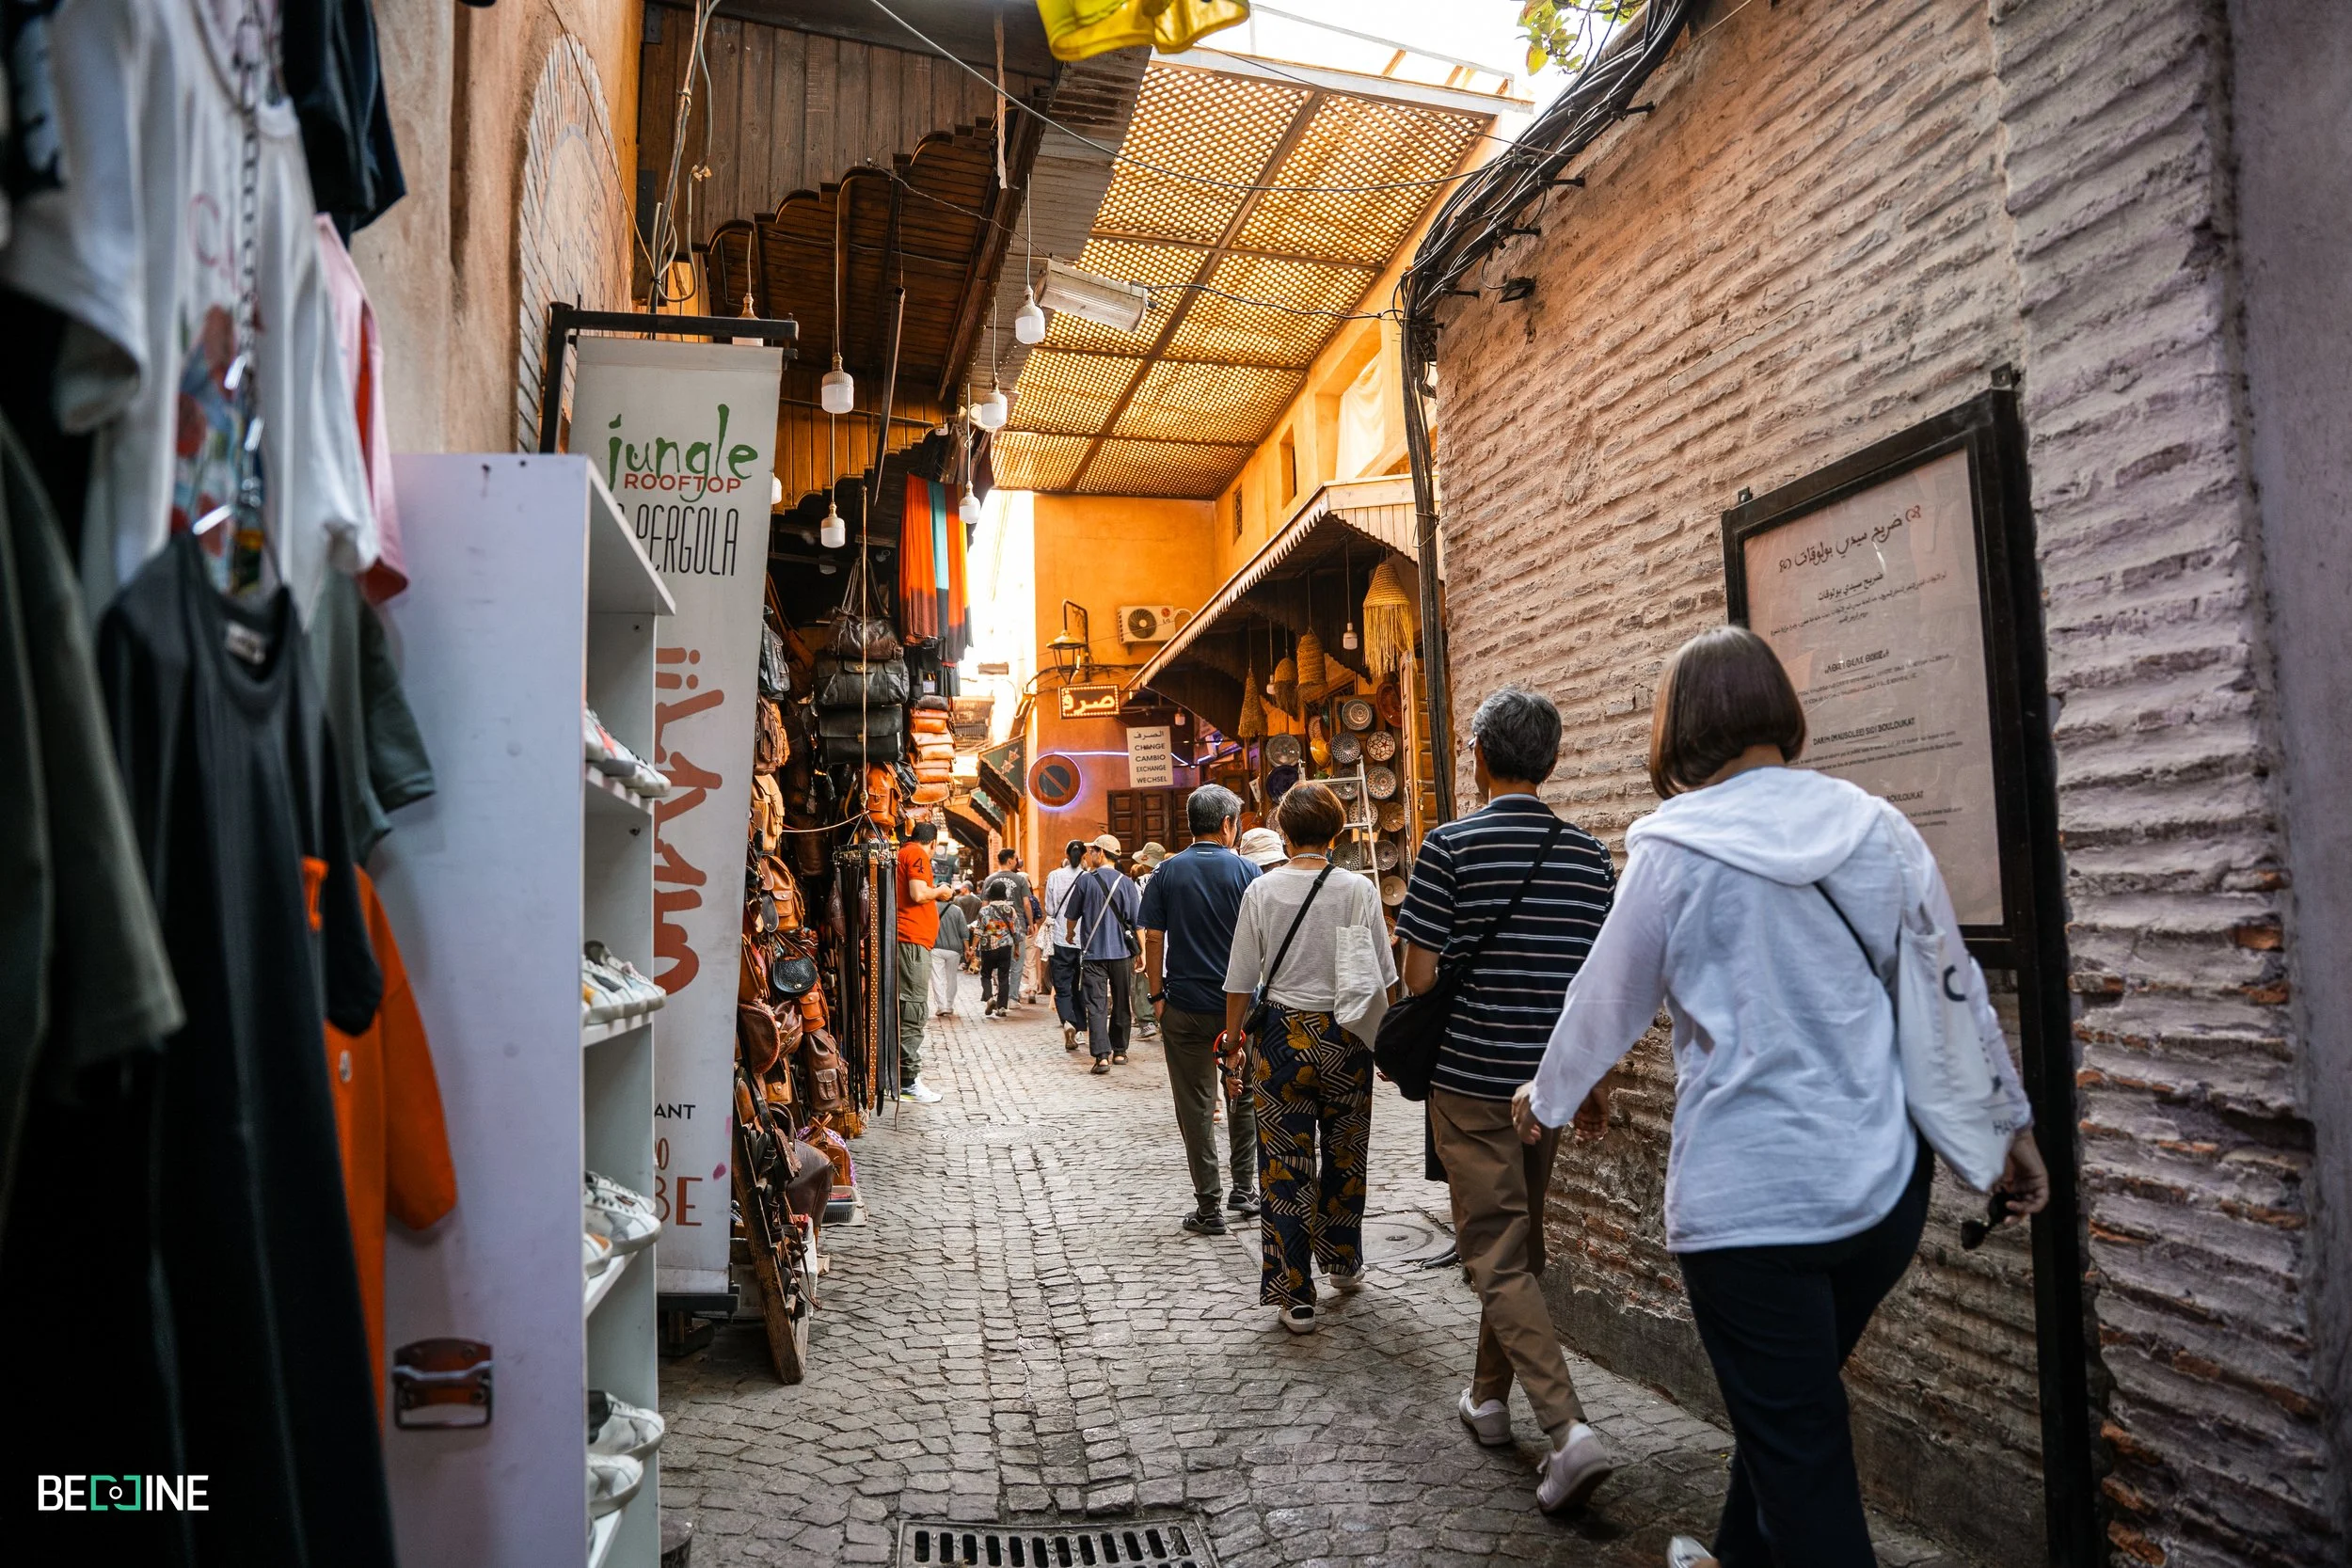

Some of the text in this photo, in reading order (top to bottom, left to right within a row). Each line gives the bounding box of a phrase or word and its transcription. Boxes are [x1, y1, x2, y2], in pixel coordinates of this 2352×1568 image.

[608, 404, 758, 502] jungle
[624, 473, 741, 494] ROOFTOP
[636, 503, 739, 576] PERGOLA
[1134, 730, 1164, 740] الصرف
[654, 1102, 696, 1119] ANT
